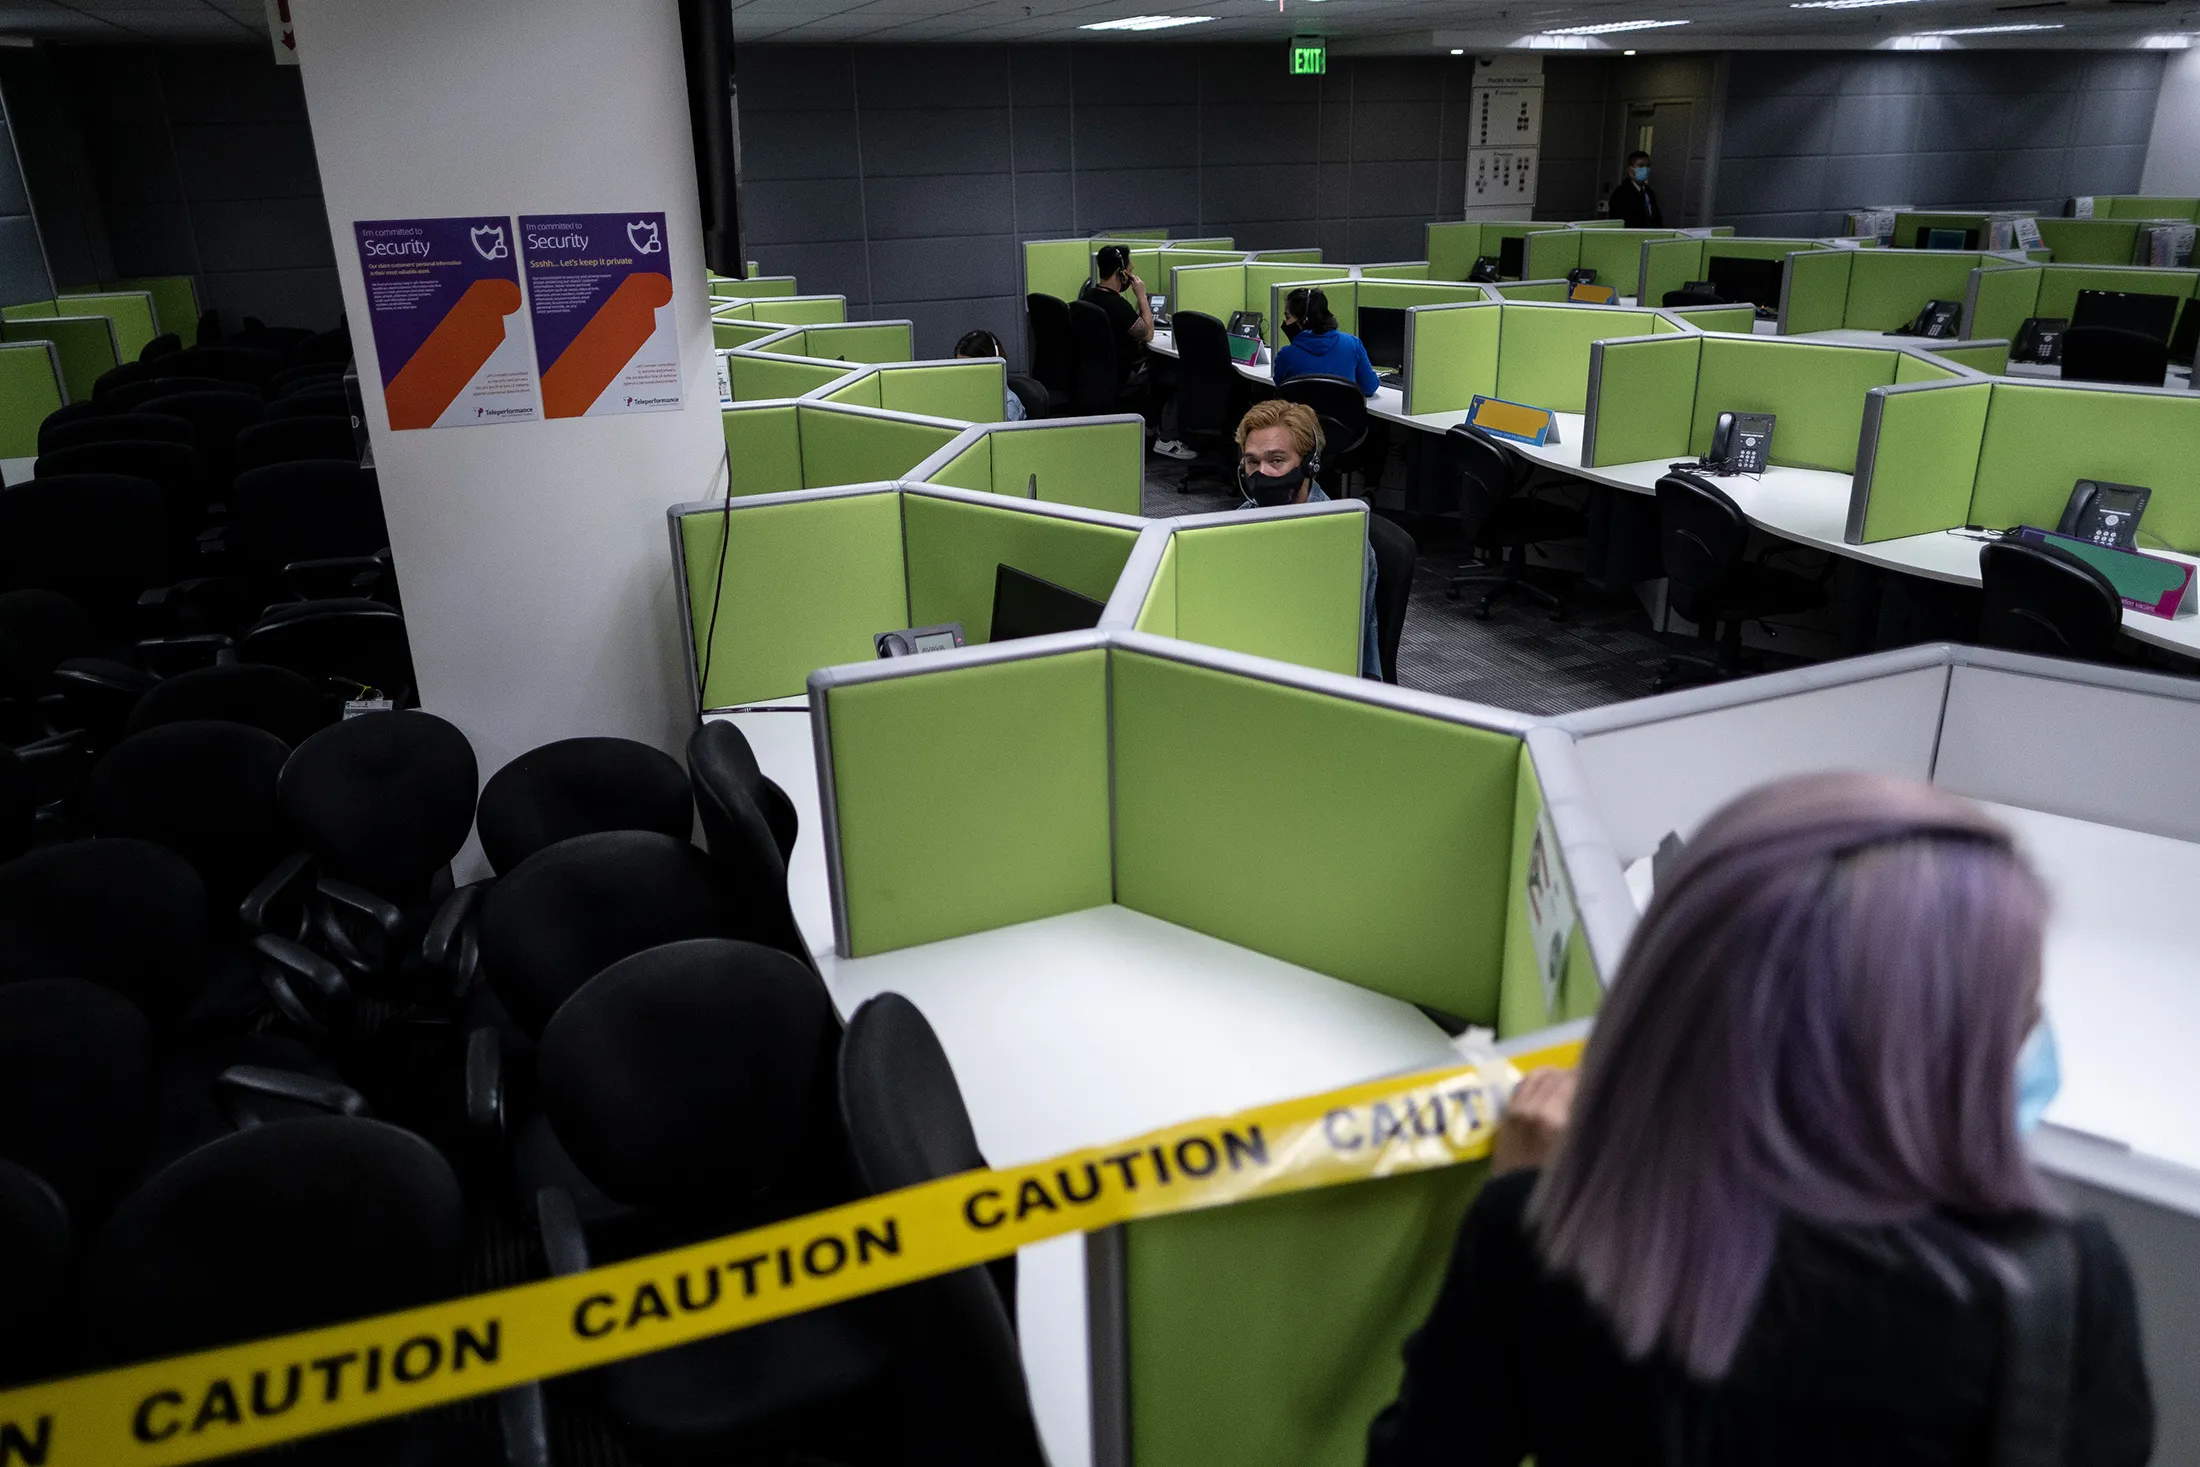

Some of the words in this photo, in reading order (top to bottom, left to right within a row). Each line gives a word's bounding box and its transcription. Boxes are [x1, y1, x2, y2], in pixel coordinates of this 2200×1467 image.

[1295, 48, 1321, 75] EXIT
[362, 228, 374, 237] I'm
[375, 227, 414, 237] committed
[414, 227, 424, 236] to
[526, 223, 537, 231] I'm
[538, 222, 574, 231] committed
[575, 222, 583, 230] to
[365, 239, 431, 257] Security
[528, 233, 588, 251] Security
[560, 259, 578, 267] Let's
[579, 258, 598, 268] keep
[599, 257, 606, 266] it
[606, 257, 633, 267] private
[634, 397, 679, 406] Teleperformance
[485, 407, 533, 417] Teleperformance
[1323, 1085, 1498, 1150] CAUT
[961, 1122, 1270, 1231] CAUTION
[571, 1217, 902, 1342] CAUTION
[132, 1320, 500, 1444] CAUTION
